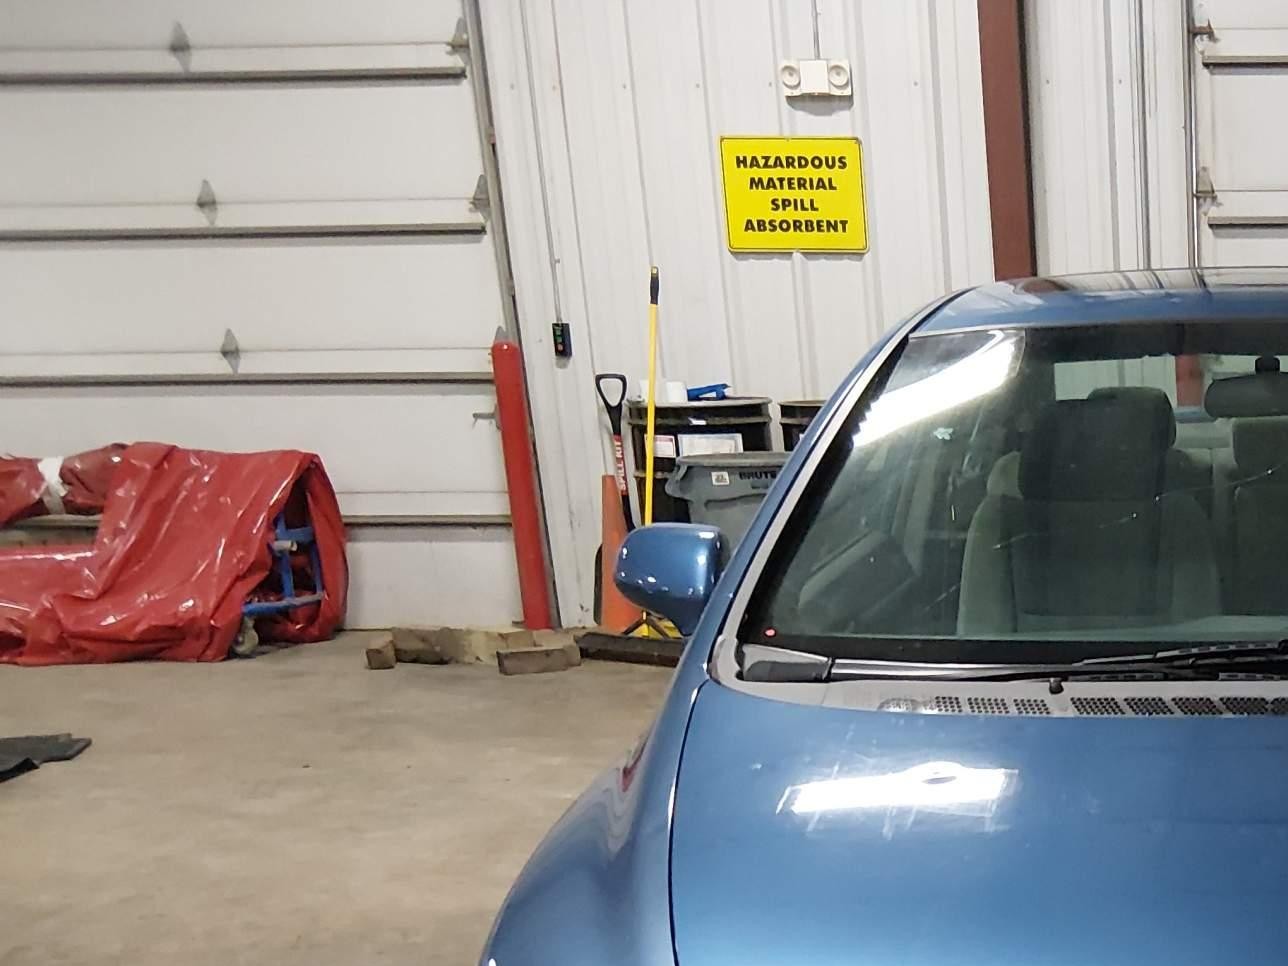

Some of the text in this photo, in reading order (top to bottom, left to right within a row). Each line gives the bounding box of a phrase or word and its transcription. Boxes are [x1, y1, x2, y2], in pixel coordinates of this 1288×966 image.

[735, 155, 848, 170] HAZARDOUS
[749, 177, 838, 191] MATERIAL
[770, 198, 819, 212] SPILL
[744, 219, 849, 233] ABSORBENT
[614, 440, 627, 490] SPILL KIT
